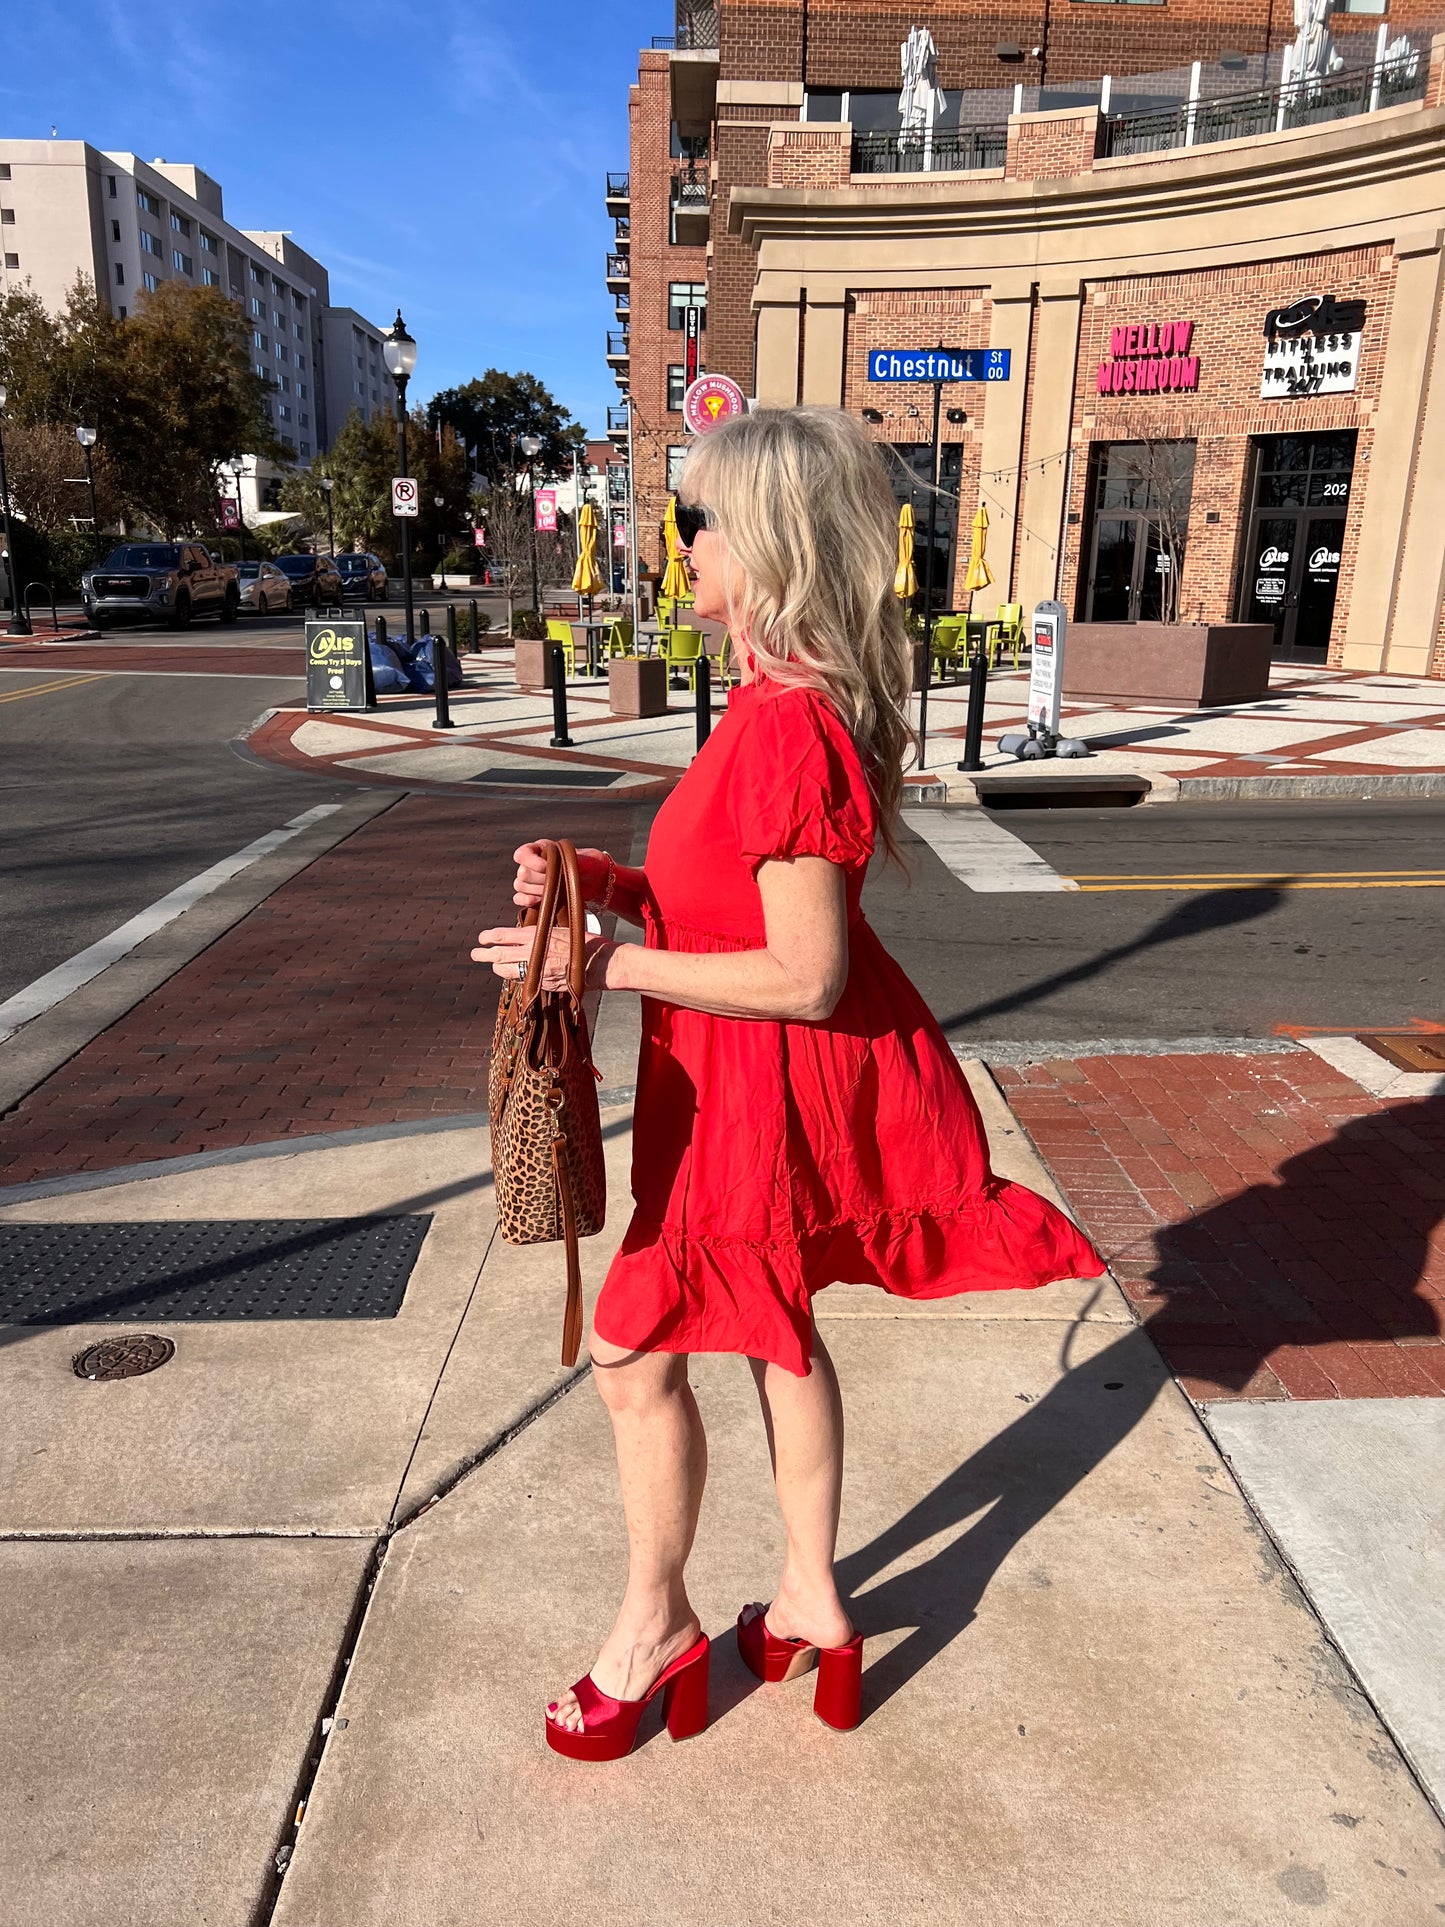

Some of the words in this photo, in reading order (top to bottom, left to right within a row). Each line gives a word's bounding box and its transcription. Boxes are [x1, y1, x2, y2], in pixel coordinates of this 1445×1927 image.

[1110, 321, 1193, 356] MELLOW
[1267, 333, 1352, 356] FITNESS
[874, 354, 973, 378] Chestnut
[990, 351, 1003, 364] St
[988, 367, 1004, 379] 00
[1096, 356, 1198, 393] MUSHROOM
[1263, 361, 1351, 382] TRAINING
[690, 383, 708, 416] MELLOW
[1323, 484, 1347, 496] 202
[538, 515, 555, 528] 100
[312, 632, 354, 654] AXIS
[328, 659, 340, 667] Try
[345, 659, 362, 667] Days
